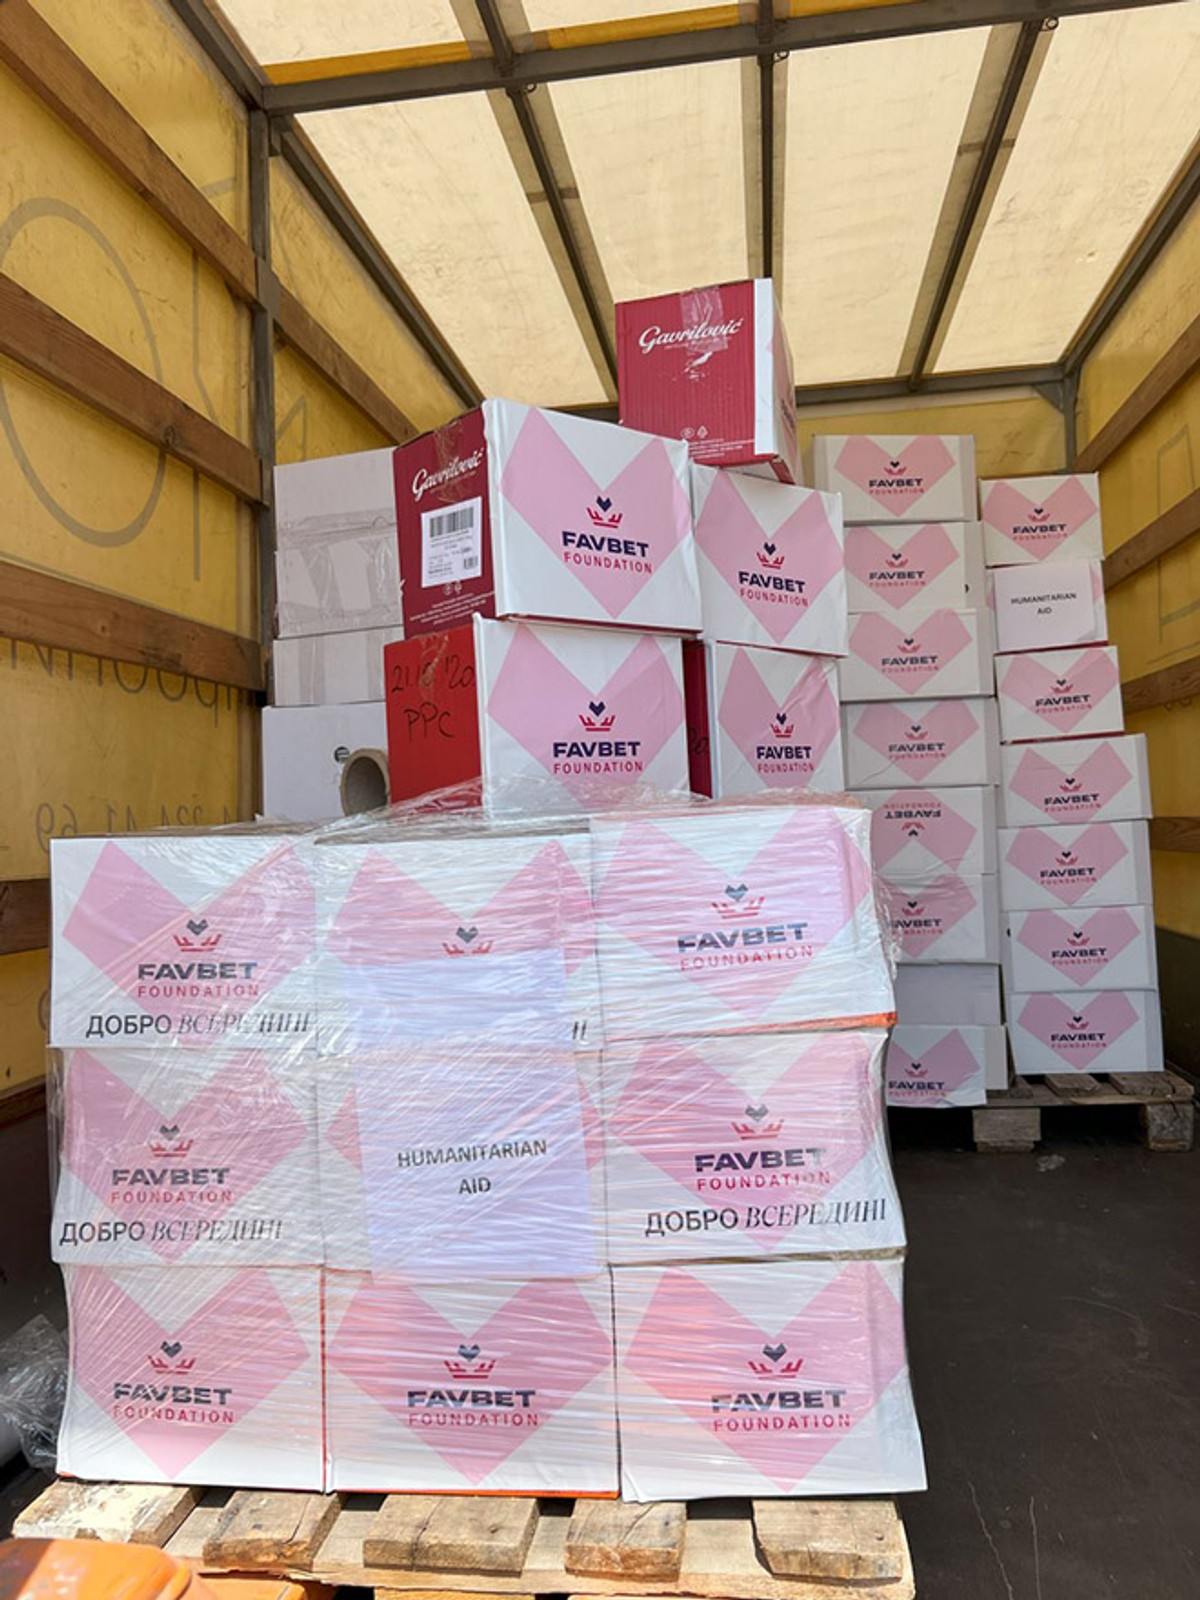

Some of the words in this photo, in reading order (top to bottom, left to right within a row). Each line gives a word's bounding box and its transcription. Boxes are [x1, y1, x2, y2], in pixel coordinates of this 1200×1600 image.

[639, 318, 743, 354] Gavrilović
[869, 478, 923, 487] FAVBET
[1013, 524, 1067, 534] FAVBET
[562, 531, 649, 558] FAVBET
[564, 552, 652, 574] FOUNDATION
[738, 571, 805, 593] FAVBET
[869, 571, 925, 579] FAVBET
[740, 590, 809, 607] FOUNDATION
[1011, 592, 1076, 605] HUMANITARIAN
[1037, 607, 1052, 615] AID
[882, 656, 938, 665] FAVBET
[1035, 694, 1090, 706] FAVBET
[404, 702, 454, 741] PPC
[553, 742, 640, 757] FAVBET
[756, 745, 812, 760] FAVBET
[889, 743, 946, 752] FAVBET
[554, 761, 643, 774] FOUNDATION
[758, 762, 814, 773] FOUNDATION
[1044, 794, 1099, 805] FAVBET
[884, 810, 941, 819] FAVBET
[1040, 867, 1095, 878] FAVBET
[678, 922, 808, 953] FAVBET
[680, 946, 812, 971] FOUNDATION
[1052, 947, 1107, 958] FAVBET
[138, 962, 257, 979] FAVBET
[137, 984, 259, 998] FOUNDATION
[86, 1014, 172, 1038] ДОБРО
[1051, 1032, 1105, 1042] FAVBET
[889, 1081, 945, 1090] FAVBET
[398, 1140, 547, 1167] HUMANITARIAN
[695, 1148, 827, 1172] FAVBET
[112, 1168, 229, 1185] FAVBET
[459, 1177, 491, 1195] AID
[111, 1191, 233, 1204] FOUNDATION
[645, 1208, 738, 1236] ДОБРО
[60, 1221, 146, 1246] ДОБРО
[113, 1382, 232, 1405] FAVBET
[408, 1390, 536, 1408] FAVBET
[711, 1389, 846, 1412] FAVBET
[112, 1405, 234, 1423] FOUNDATION
[409, 1414, 538, 1426] FOUNDATION
[714, 1414, 851, 1432] FOUNDATION
